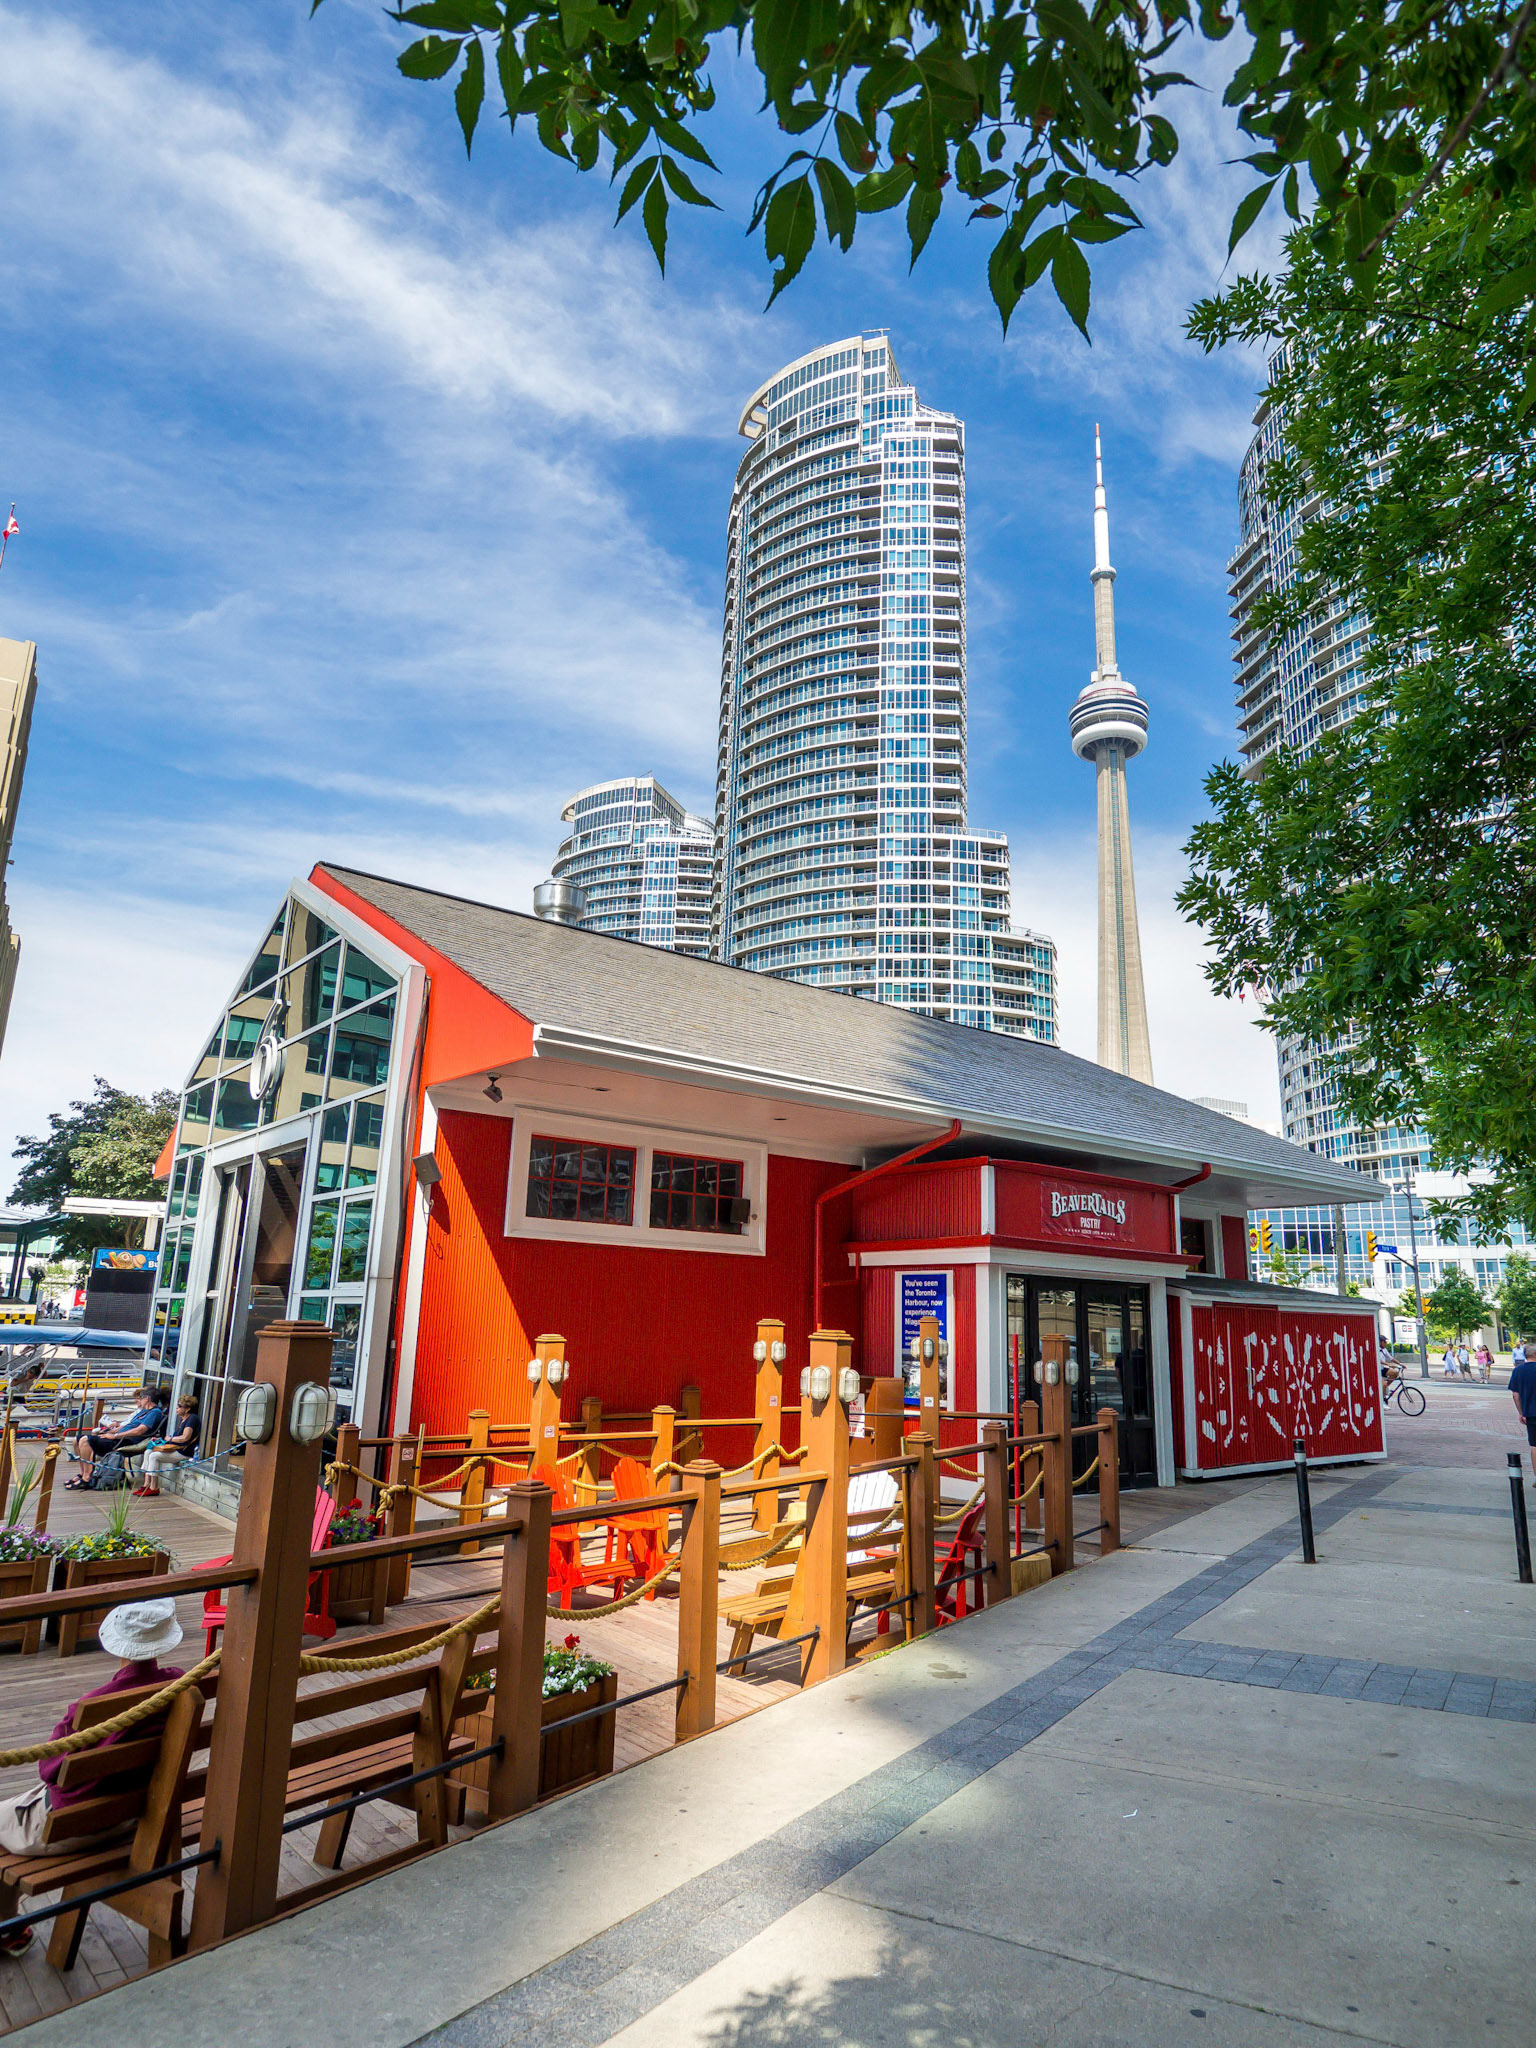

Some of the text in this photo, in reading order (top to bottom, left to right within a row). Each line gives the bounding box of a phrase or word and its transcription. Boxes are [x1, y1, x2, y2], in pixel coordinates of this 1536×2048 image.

[1080, 1217, 1100, 1229] PASTRY
[905, 1299, 930, 1307] Harbour,
[904, 1309, 936, 1317] experience
